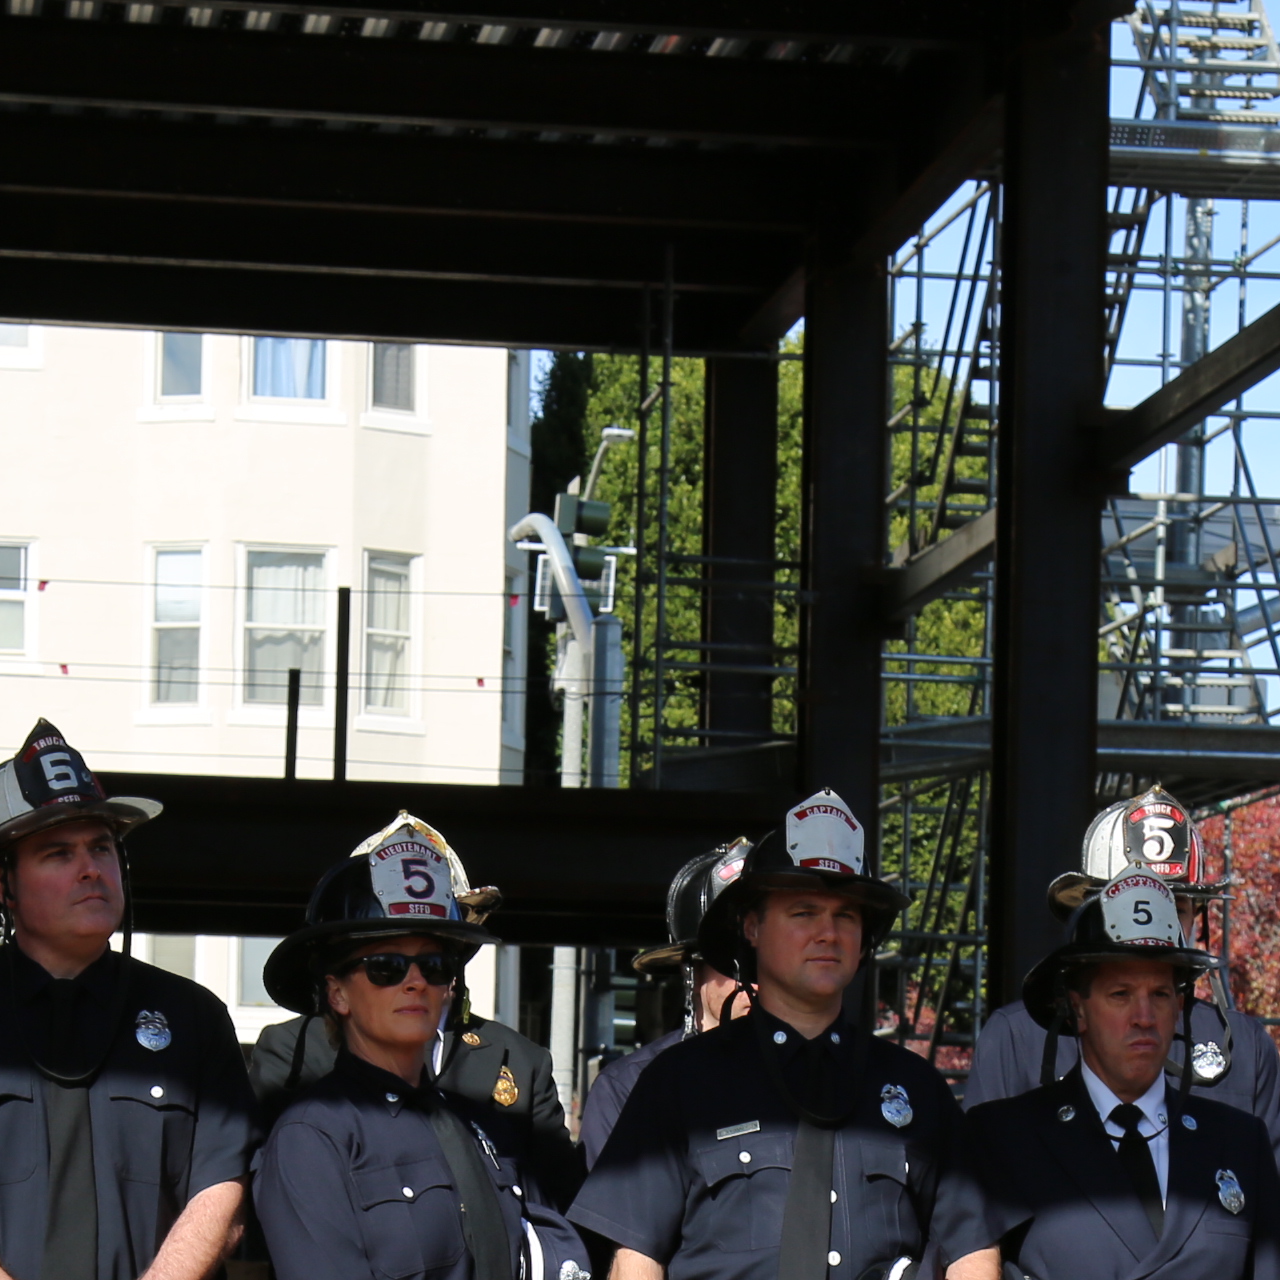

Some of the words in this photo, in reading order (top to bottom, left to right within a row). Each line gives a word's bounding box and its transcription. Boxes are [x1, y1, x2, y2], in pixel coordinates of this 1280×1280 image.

[40, 752, 78, 789] 5
[806, 806, 847, 820] CAPTAIN
[1144, 803, 1172, 815] TRUCK
[1143, 817, 1175, 862] 5
[380, 842, 437, 861] LIEUTENANT
[819, 859, 841, 872] SFFD
[401, 858, 436, 900] 5
[1108, 875, 1170, 898] CAPTAIN
[408, 903, 431, 914] SFFD
[1132, 900, 1153, 926] 5
